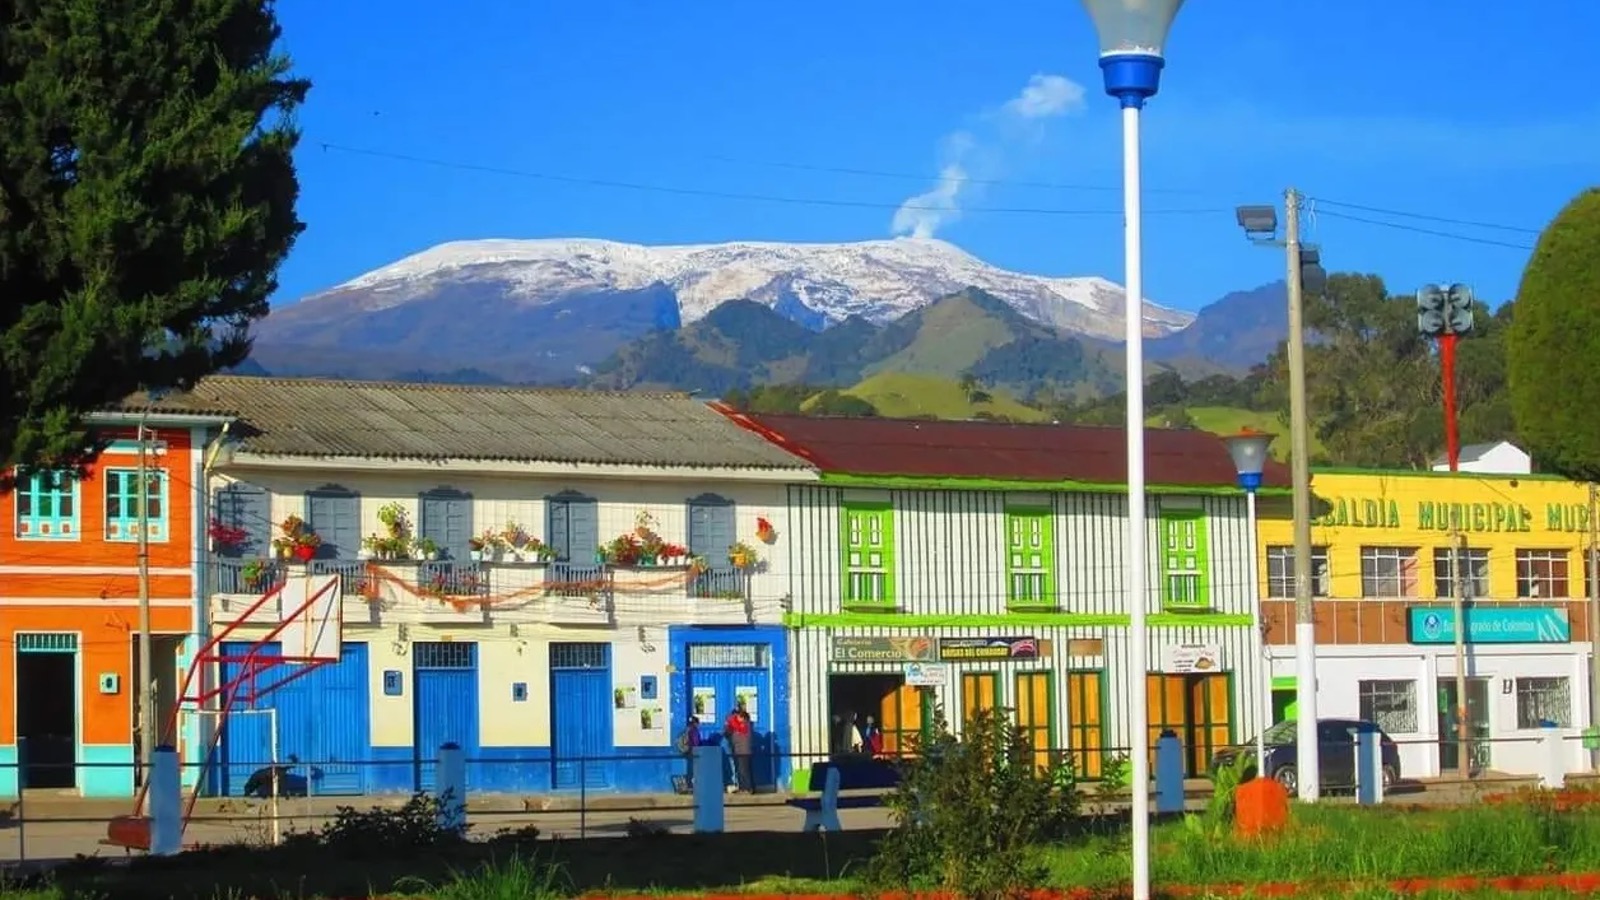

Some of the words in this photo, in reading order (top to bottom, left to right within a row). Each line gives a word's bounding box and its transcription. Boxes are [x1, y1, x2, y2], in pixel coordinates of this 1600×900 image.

[1418, 501, 1531, 532] MUNICIPAL
[835, 647, 846, 658] El
[848, 647, 902, 658] Comercio
